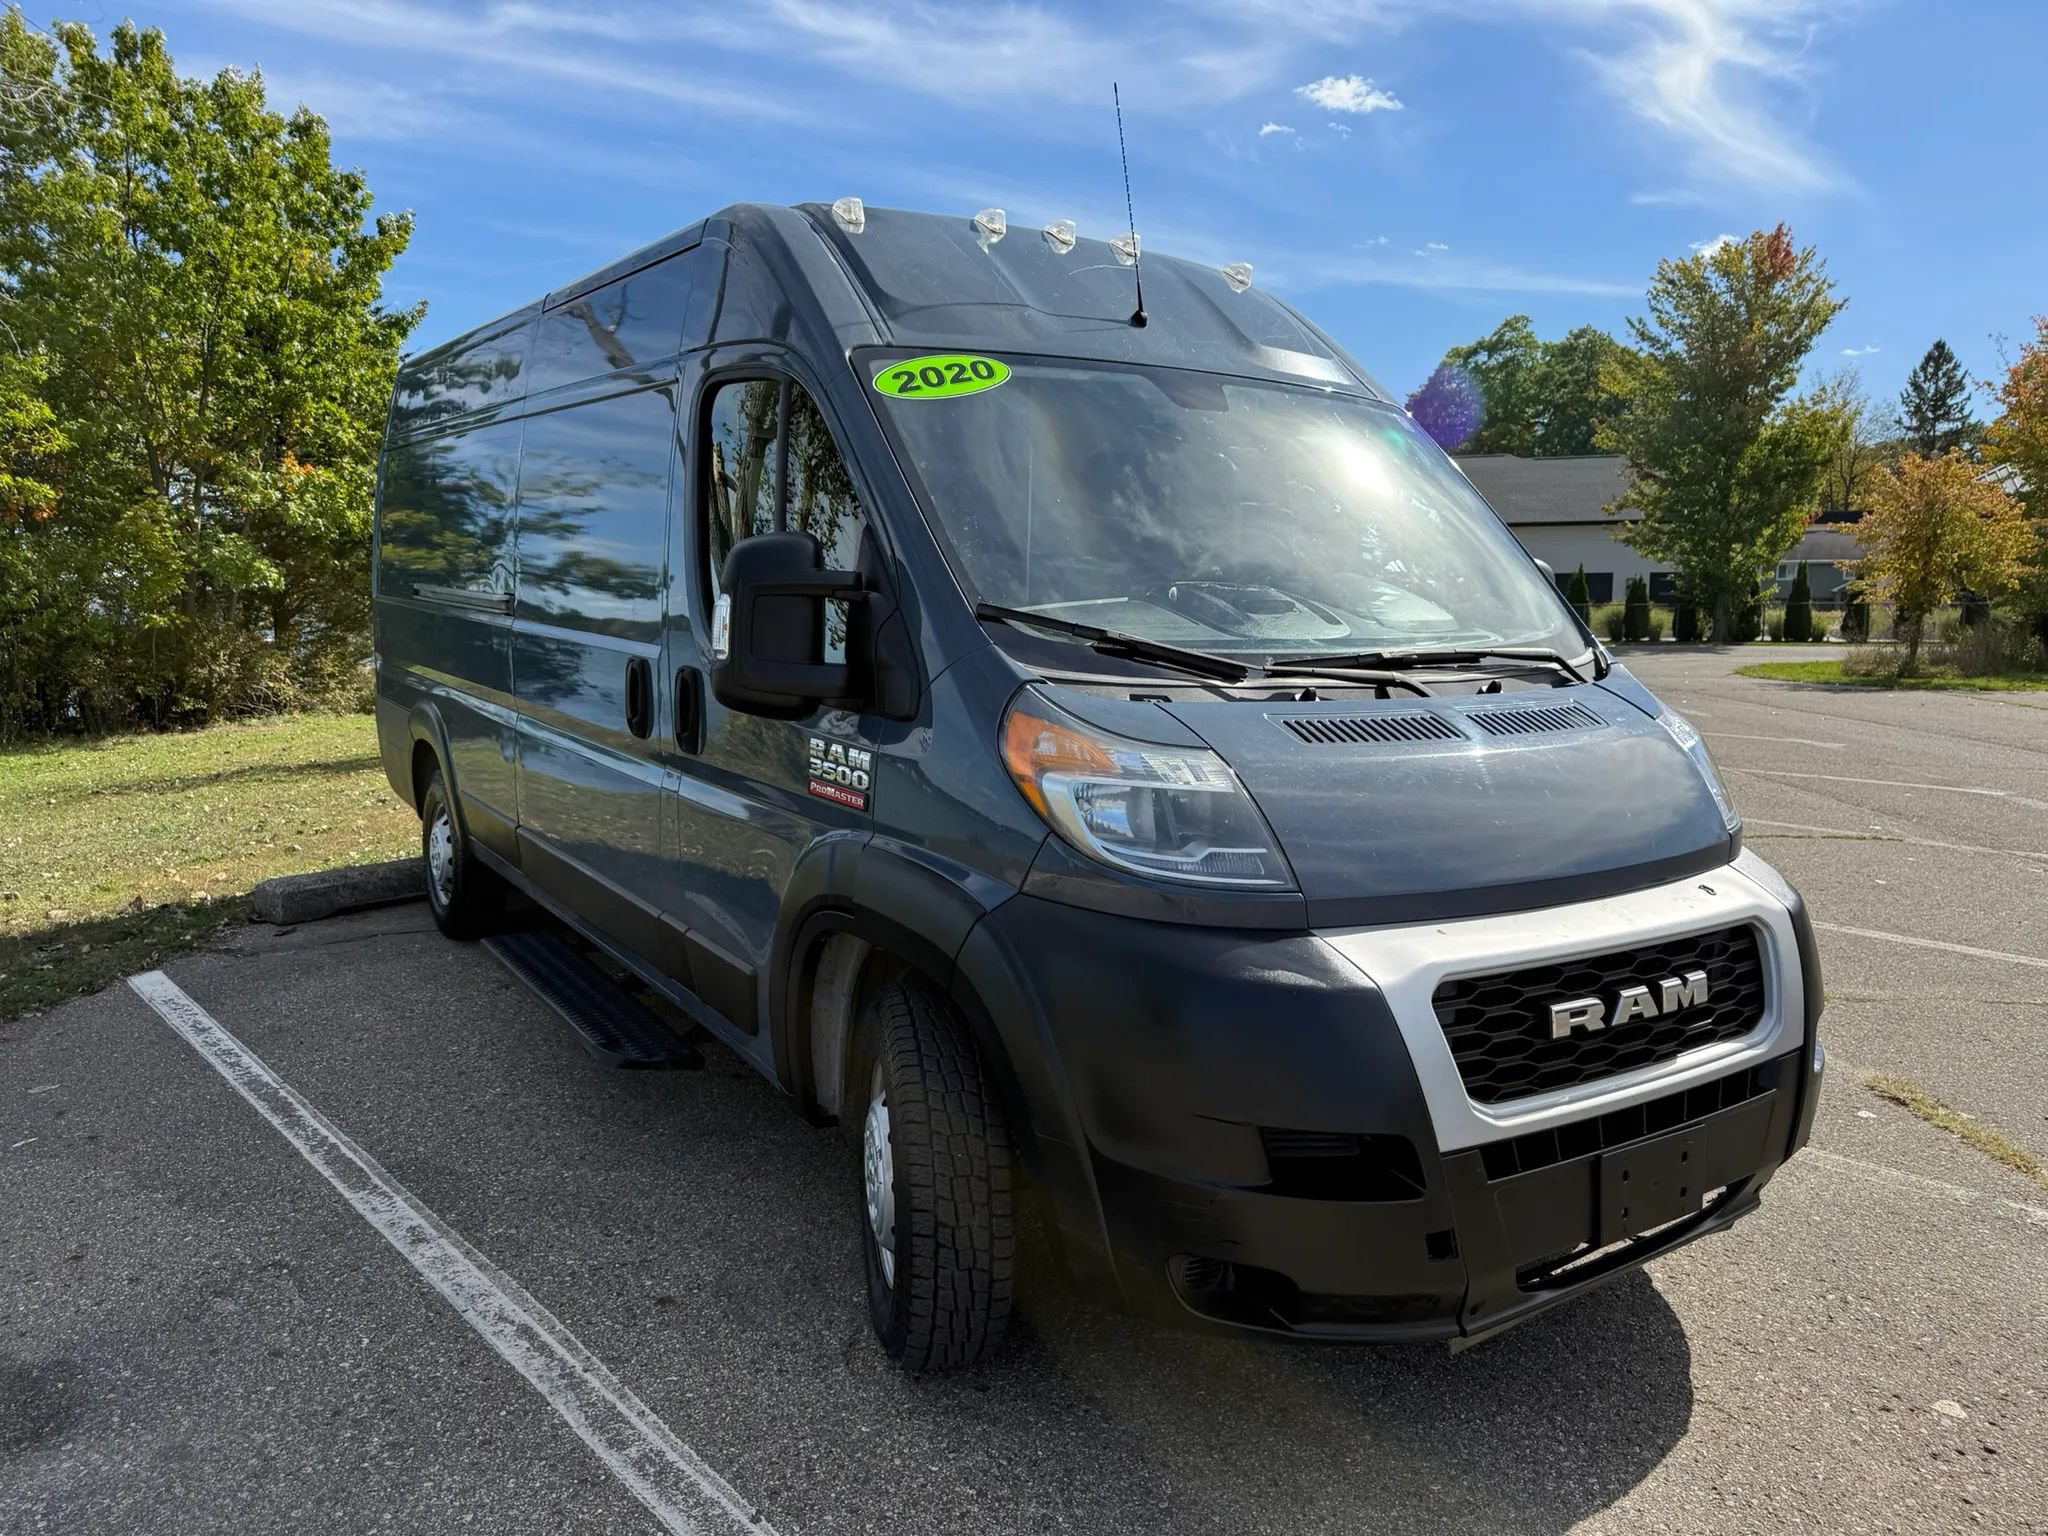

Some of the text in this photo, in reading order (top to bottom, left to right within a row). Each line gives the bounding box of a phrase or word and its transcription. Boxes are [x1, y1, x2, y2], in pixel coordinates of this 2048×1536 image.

[891, 360, 996, 393] 2020
[809, 737, 871, 771] RAM
[808, 757, 870, 790] 3500
[1550, 970, 1708, 1039] RAM
